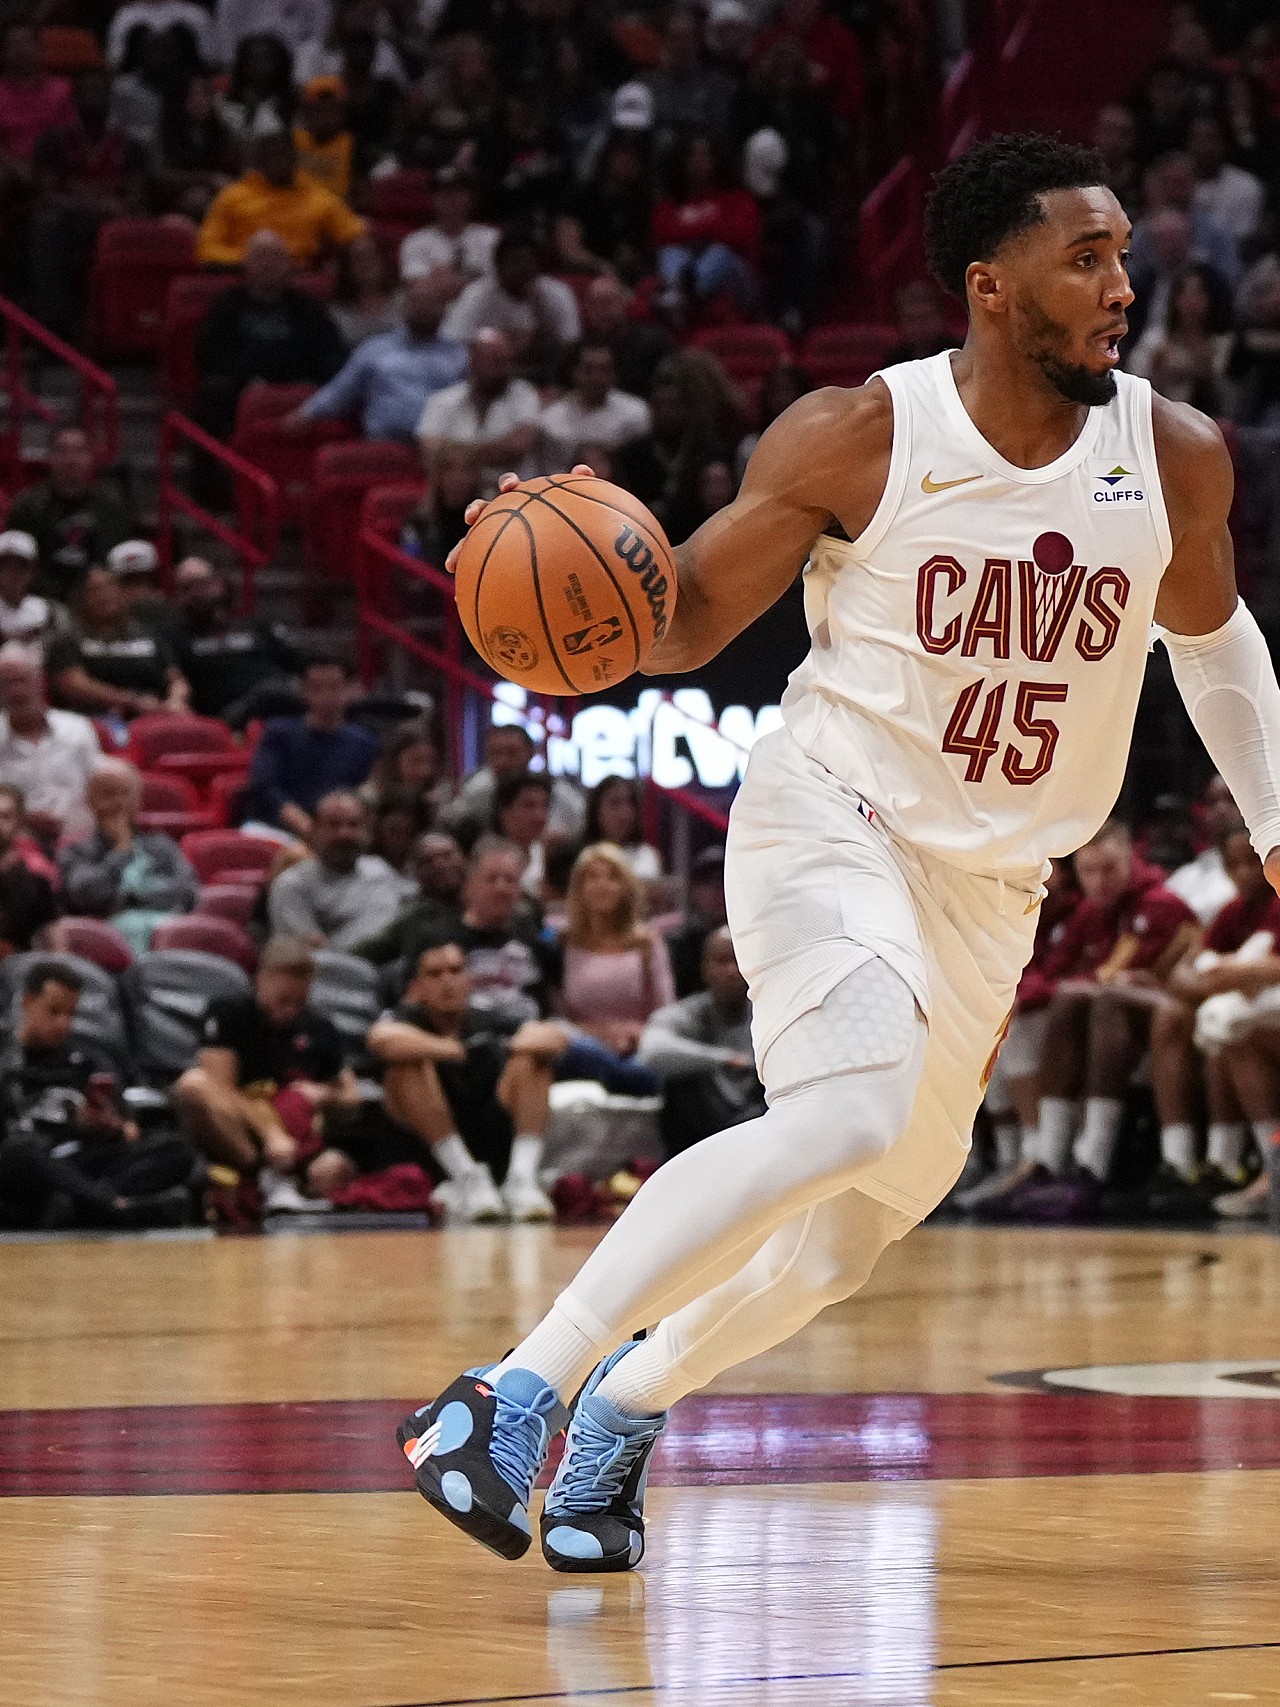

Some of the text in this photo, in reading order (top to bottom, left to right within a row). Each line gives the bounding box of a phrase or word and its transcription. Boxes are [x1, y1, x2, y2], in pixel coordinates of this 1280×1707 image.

[1093, 489, 1144, 503] CLIFFS
[916, 554, 1131, 663] CAVS
[941, 677, 1069, 786] 45
